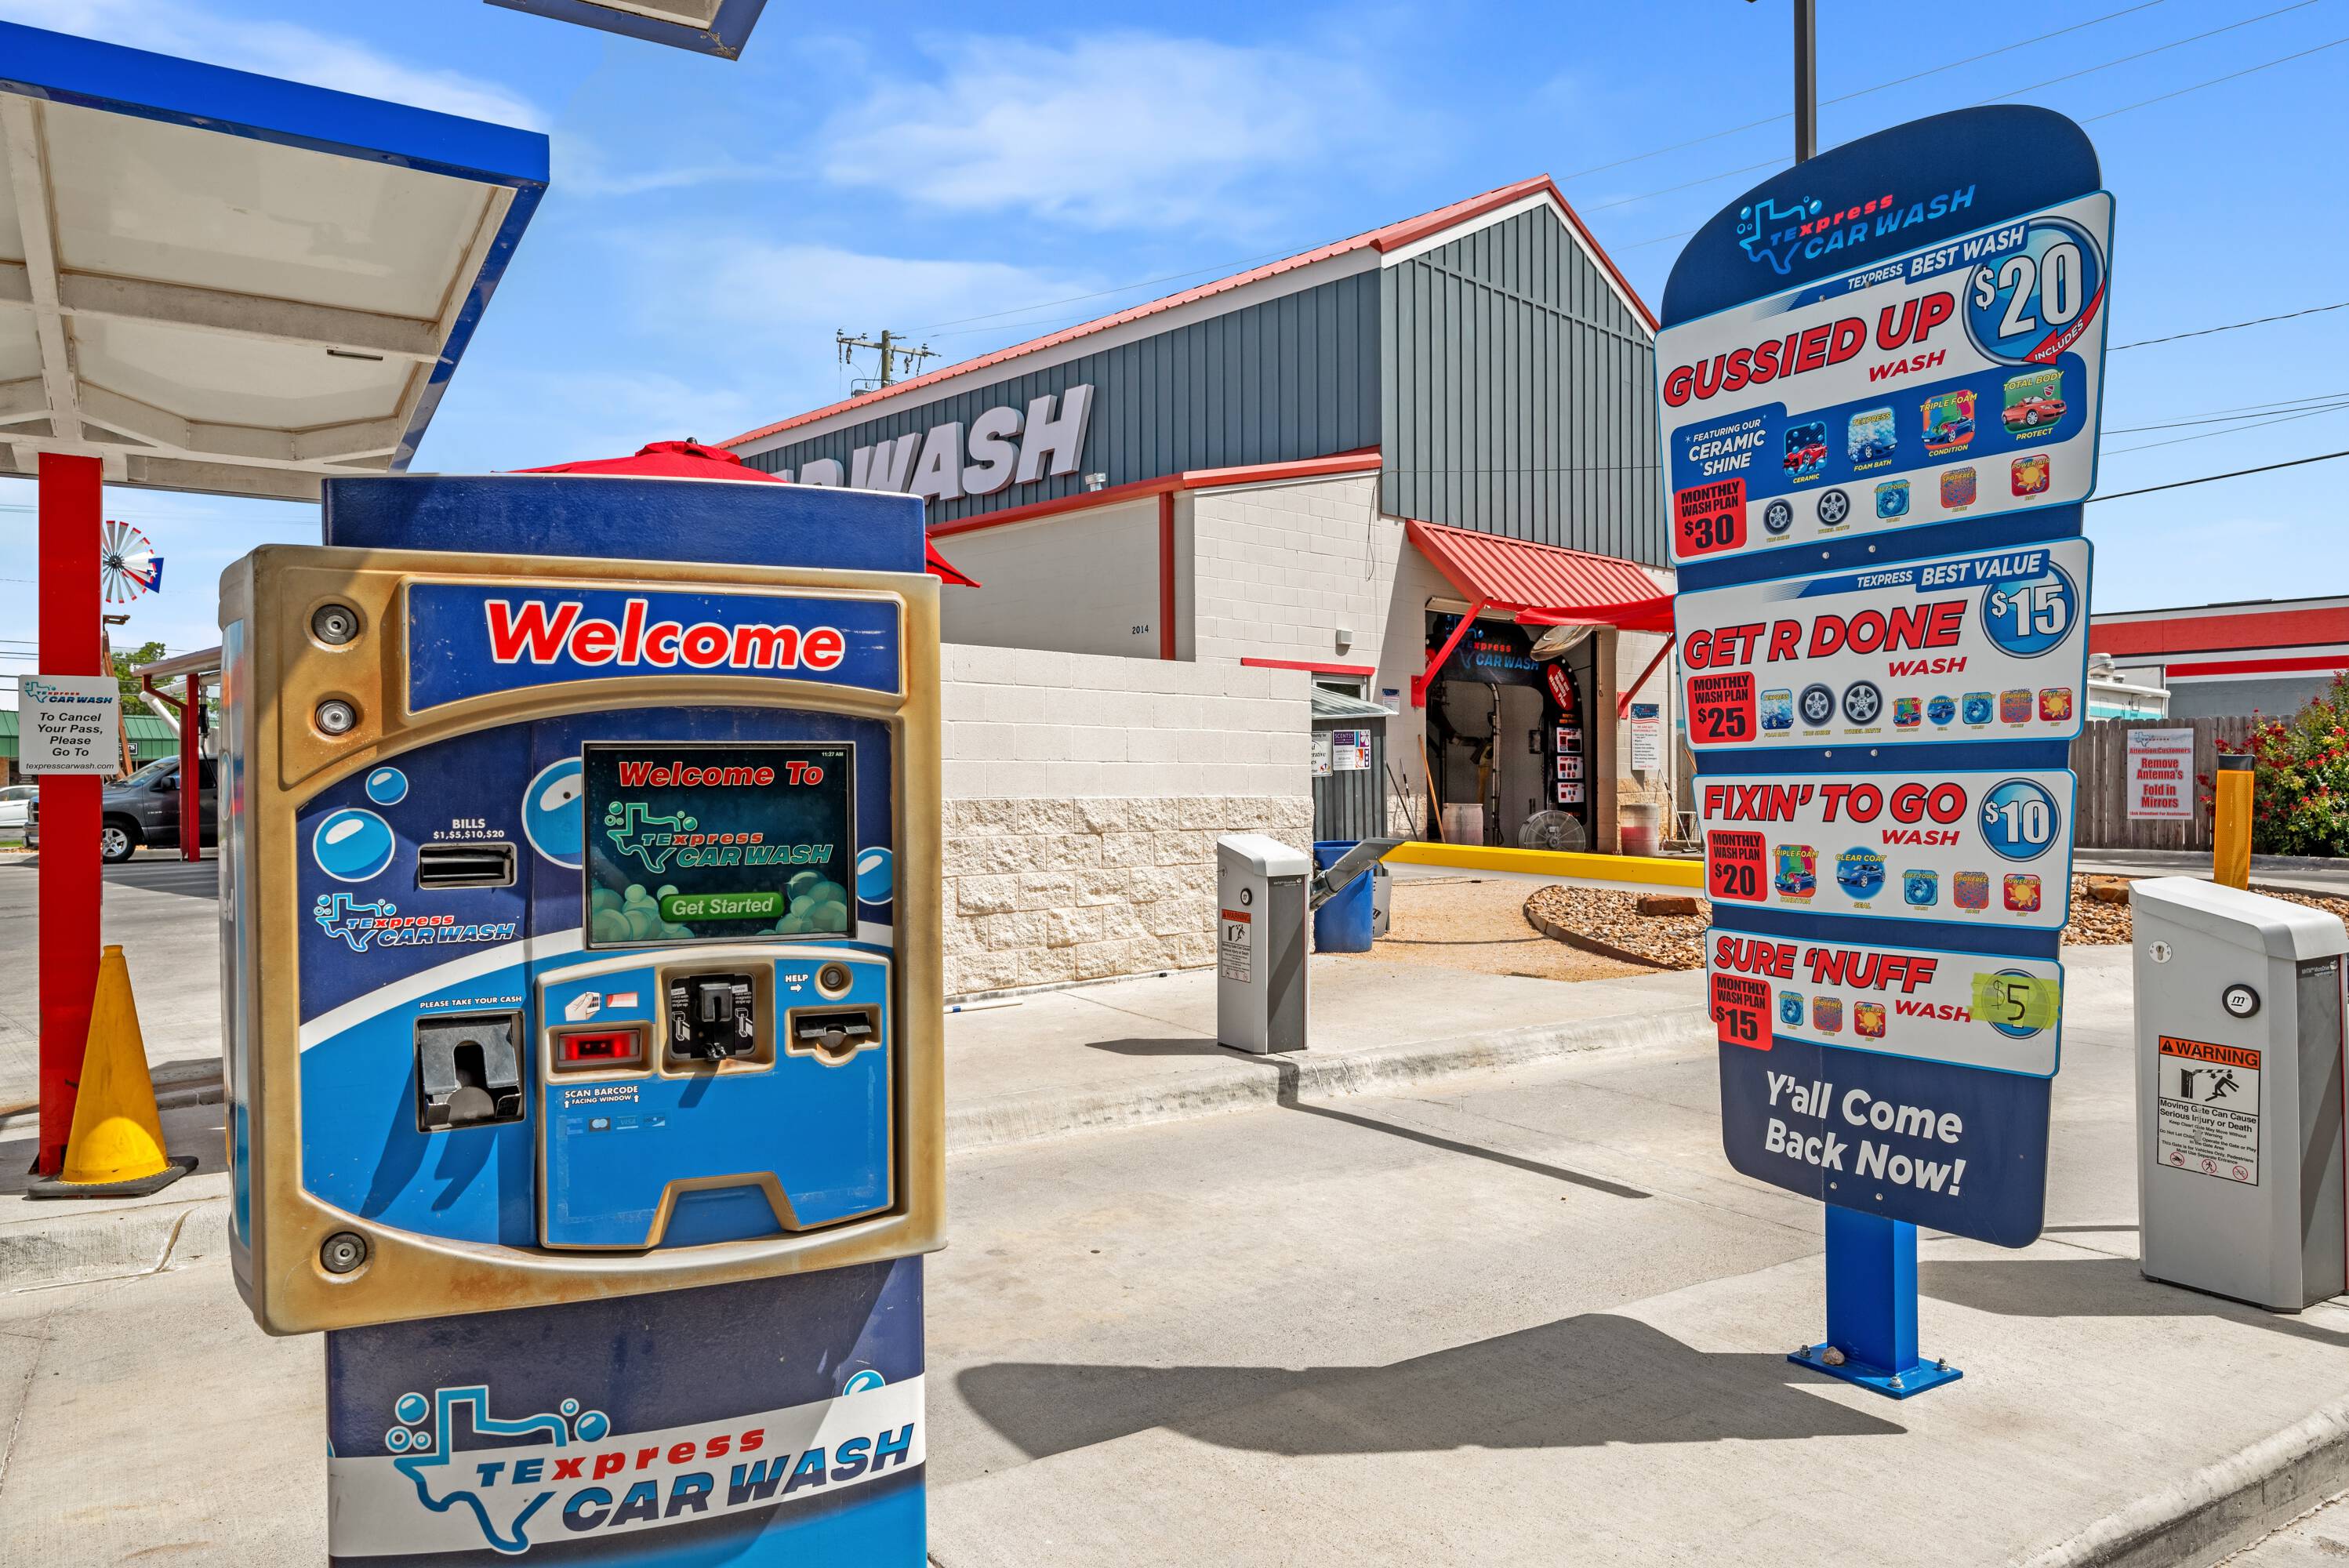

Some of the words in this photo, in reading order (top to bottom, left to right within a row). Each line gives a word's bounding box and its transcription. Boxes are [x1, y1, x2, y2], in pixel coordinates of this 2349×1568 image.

[1770, 194, 1893, 246] TExpress
[1804, 223, 1868, 259] CAR
[1875, 184, 1976, 237] WASH
[1847, 263, 1904, 290] TEXPRESS
[1911, 245, 1959, 278] BEST
[1962, 225, 2024, 261] WASH
[1974, 241, 2084, 339] $20
[1664, 317, 1867, 408] GUSSIED
[1876, 292, 1955, 351] UP
[2035, 319, 2083, 361] INCLUDES
[1868, 350, 1946, 383] WASH
[2003, 379, 2032, 391] TOTAL
[2035, 371, 2064, 384] BODY
[1919, 399, 1949, 412] TRIPLE
[1951, 393, 1977, 407] FOAM
[1694, 423, 1740, 442] FEATURING
[1742, 419, 1760, 430] OUR
[1852, 412, 1891, 426] TEXPRESS
[850, 383, 1095, 506] WASH
[1689, 430, 1766, 462] CERAMIC
[2016, 428, 2053, 441] PROTECT
[1929, 445, 1968, 457] CONDITION
[1703, 452, 1752, 477] SHINE
[1853, 463, 1872, 471] FOAM
[1874, 459, 1892, 468] BATH
[1793, 474, 1820, 484] CERAMIC
[1681, 481, 1740, 504] MONTHLY
[1682, 501, 1712, 517] WASH
[1713, 495, 1738, 510] PLAN
[1684, 514, 1734, 549] $30
[1857, 571, 1912, 588] TEXPRESS
[1922, 561, 1971, 586] BEST
[1974, 554, 2042, 579] VALUE
[1991, 584, 2067, 637] $15
[485, 599, 846, 671] Welcome
[1132, 625, 1149, 634] 2014
[1683, 622, 1766, 670] GET
[1767, 619, 1802, 662] R
[1807, 599, 1968, 659] DONE
[1476, 653, 1501, 666] CAR
[1504, 656, 1539, 670] WASH
[1889, 657, 1967, 677] WASH
[1694, 675, 1749, 691] MONTHLY
[1694, 691, 1723, 704] WASH
[1725, 688, 1748, 701] PLAN
[59, 713, 101, 721] Cancel
[1697, 707, 1745, 738] $25
[70, 724, 103, 734] Pass,
[619, 761, 774, 786] Welcome
[786, 761, 823, 785] To
[2137, 769, 2183, 779] Antenna's
[2141, 758, 2179, 768] Remove
[2144, 785, 2163, 795] Fold
[2166, 784, 2176, 795] in
[1704, 784, 1814, 822] FIXIN'
[1820, 783, 1883, 823] TO
[1890, 782, 1967, 824] GO
[2141, 797, 2178, 808] Mirrors
[452, 818, 485, 829] BILLS
[1984, 800, 2050, 844] $10
[434, 830, 504, 840] $1,$5,$10,$20
[641, 833, 763, 847] TExpress
[1712, 833, 1760, 848] MONTHLY
[1882, 829, 1960, 846] WASH
[677, 847, 741, 867] CAR
[745, 844, 833, 866] WASH
[1713, 847, 1737, 858] WASH
[1739, 849, 1760, 861] PLAN
[1715, 862, 1755, 896] $20
[672, 902, 703, 916] Get
[708, 897, 774, 914] Started
[346, 915, 455, 930] TExpress
[377, 927, 437, 947] CAR
[438, 923, 515, 943] WASH
[1714, 936, 1798, 979] SURE
[1804, 947, 1938, 993] 'NUFF
[1717, 977, 1766, 995] MONTHLY
[419, 1000, 449, 1009] PLEASE
[1717, 989, 1742, 1005] WASH
[1744, 995, 1765, 1010] PLAN
[1991, 980, 2029, 1021] $5
[1895, 1000, 1971, 1023] WASH
[1715, 1006, 1759, 1041] $15
[2176, 1041, 2258, 1066] WARNING
[565, 1089, 591, 1098] SCAN
[594, 1086, 638, 1096] BARCODE
[1766, 1070, 1833, 1119] Y'all
[1843, 1089, 1962, 1144] Come
[2160, 1099, 2189, 1112] Moving
[2212, 1109, 2227, 1119] Can
[2230, 1113, 2257, 1123] Cause
[2160, 1109, 2190, 1120] Serious
[2192, 1114, 2215, 1126] Injury
[2228, 1121, 2252, 1132] Death
[1765, 1117, 1849, 1171] Back
[1855, 1140, 1966, 1196] Now!
[476, 1428, 765, 1487] TExpress
[562, 1471, 714, 1533] CAR
[727, 1422, 914, 1506] WASH
